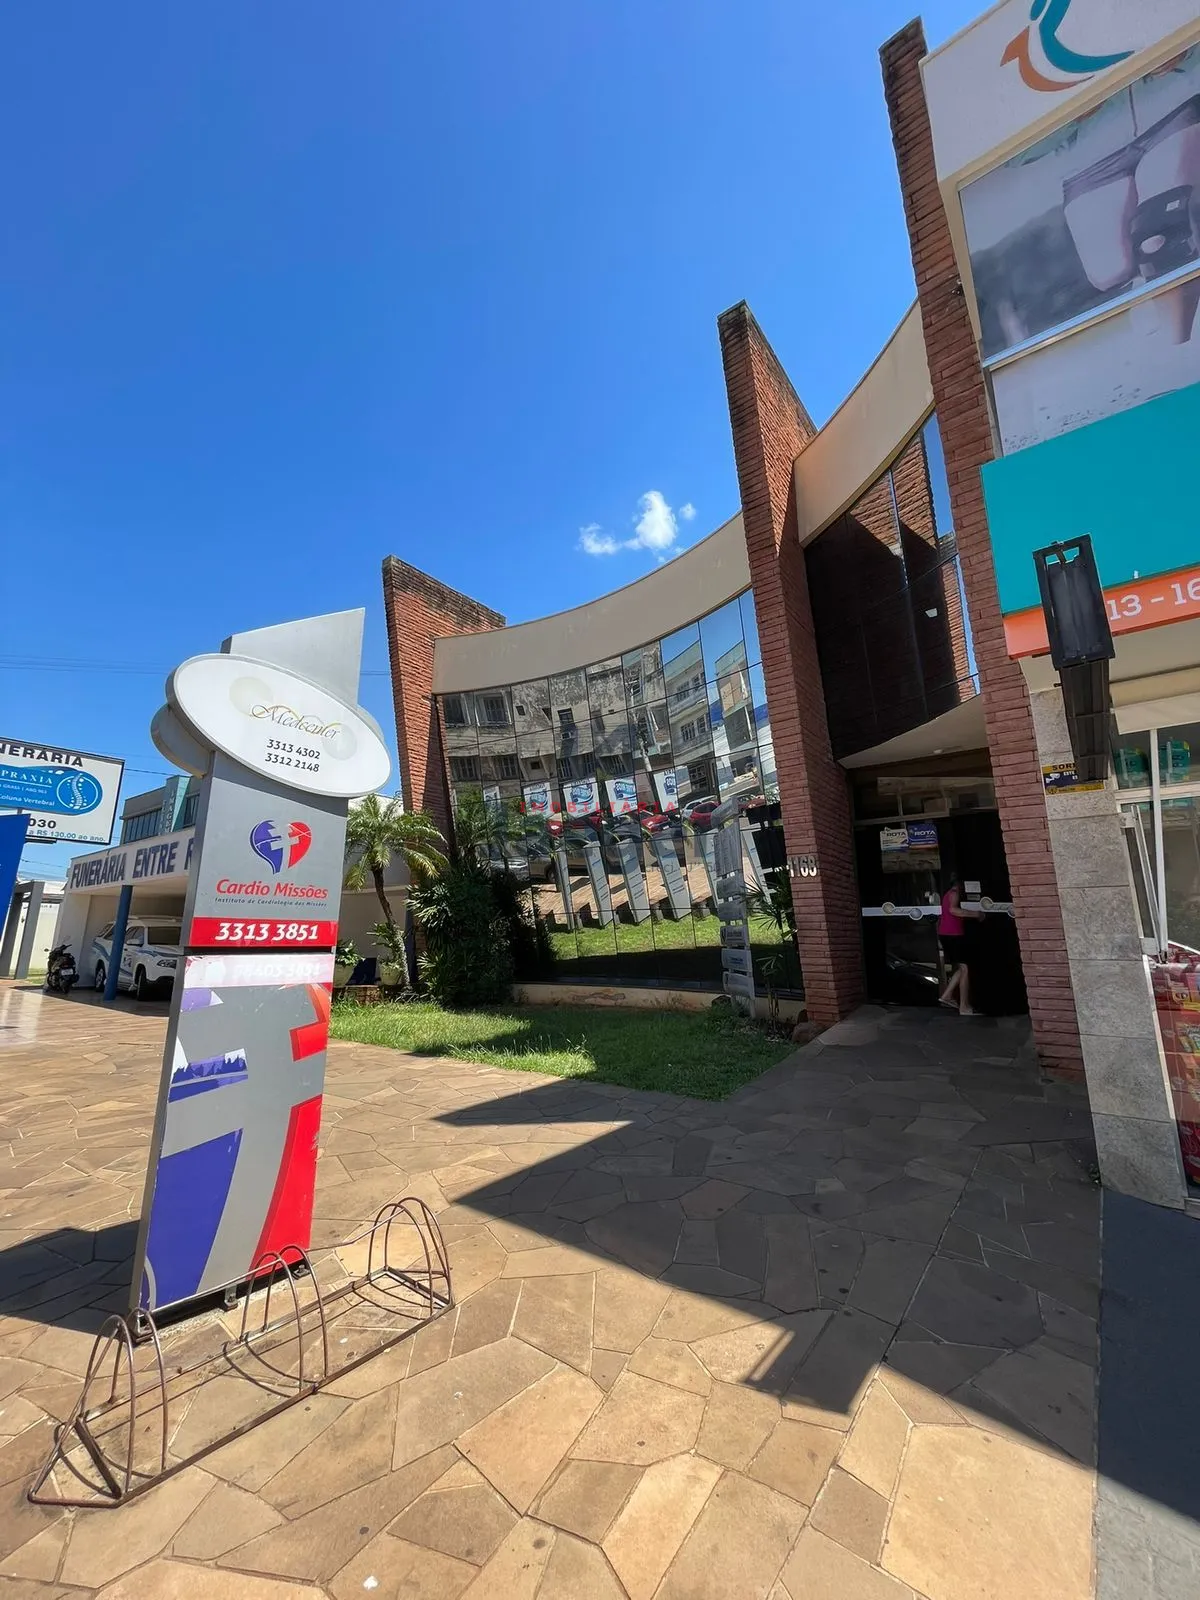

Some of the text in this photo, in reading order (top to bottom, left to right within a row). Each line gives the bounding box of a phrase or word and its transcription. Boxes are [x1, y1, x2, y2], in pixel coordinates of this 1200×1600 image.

[251, 704, 340, 739] Medcenter
[266, 739, 320, 760] 3313 4302
[265, 752, 320, 773] 3312 2148
[1, 770, 53, 785] PRAXIA
[70, 851, 127, 889] FUNERÁRIA
[132, 841, 179, 879] ENTRE
[216, 879, 328, 899] Cardio Missões
[215, 922, 319, 941] 3313 3851
